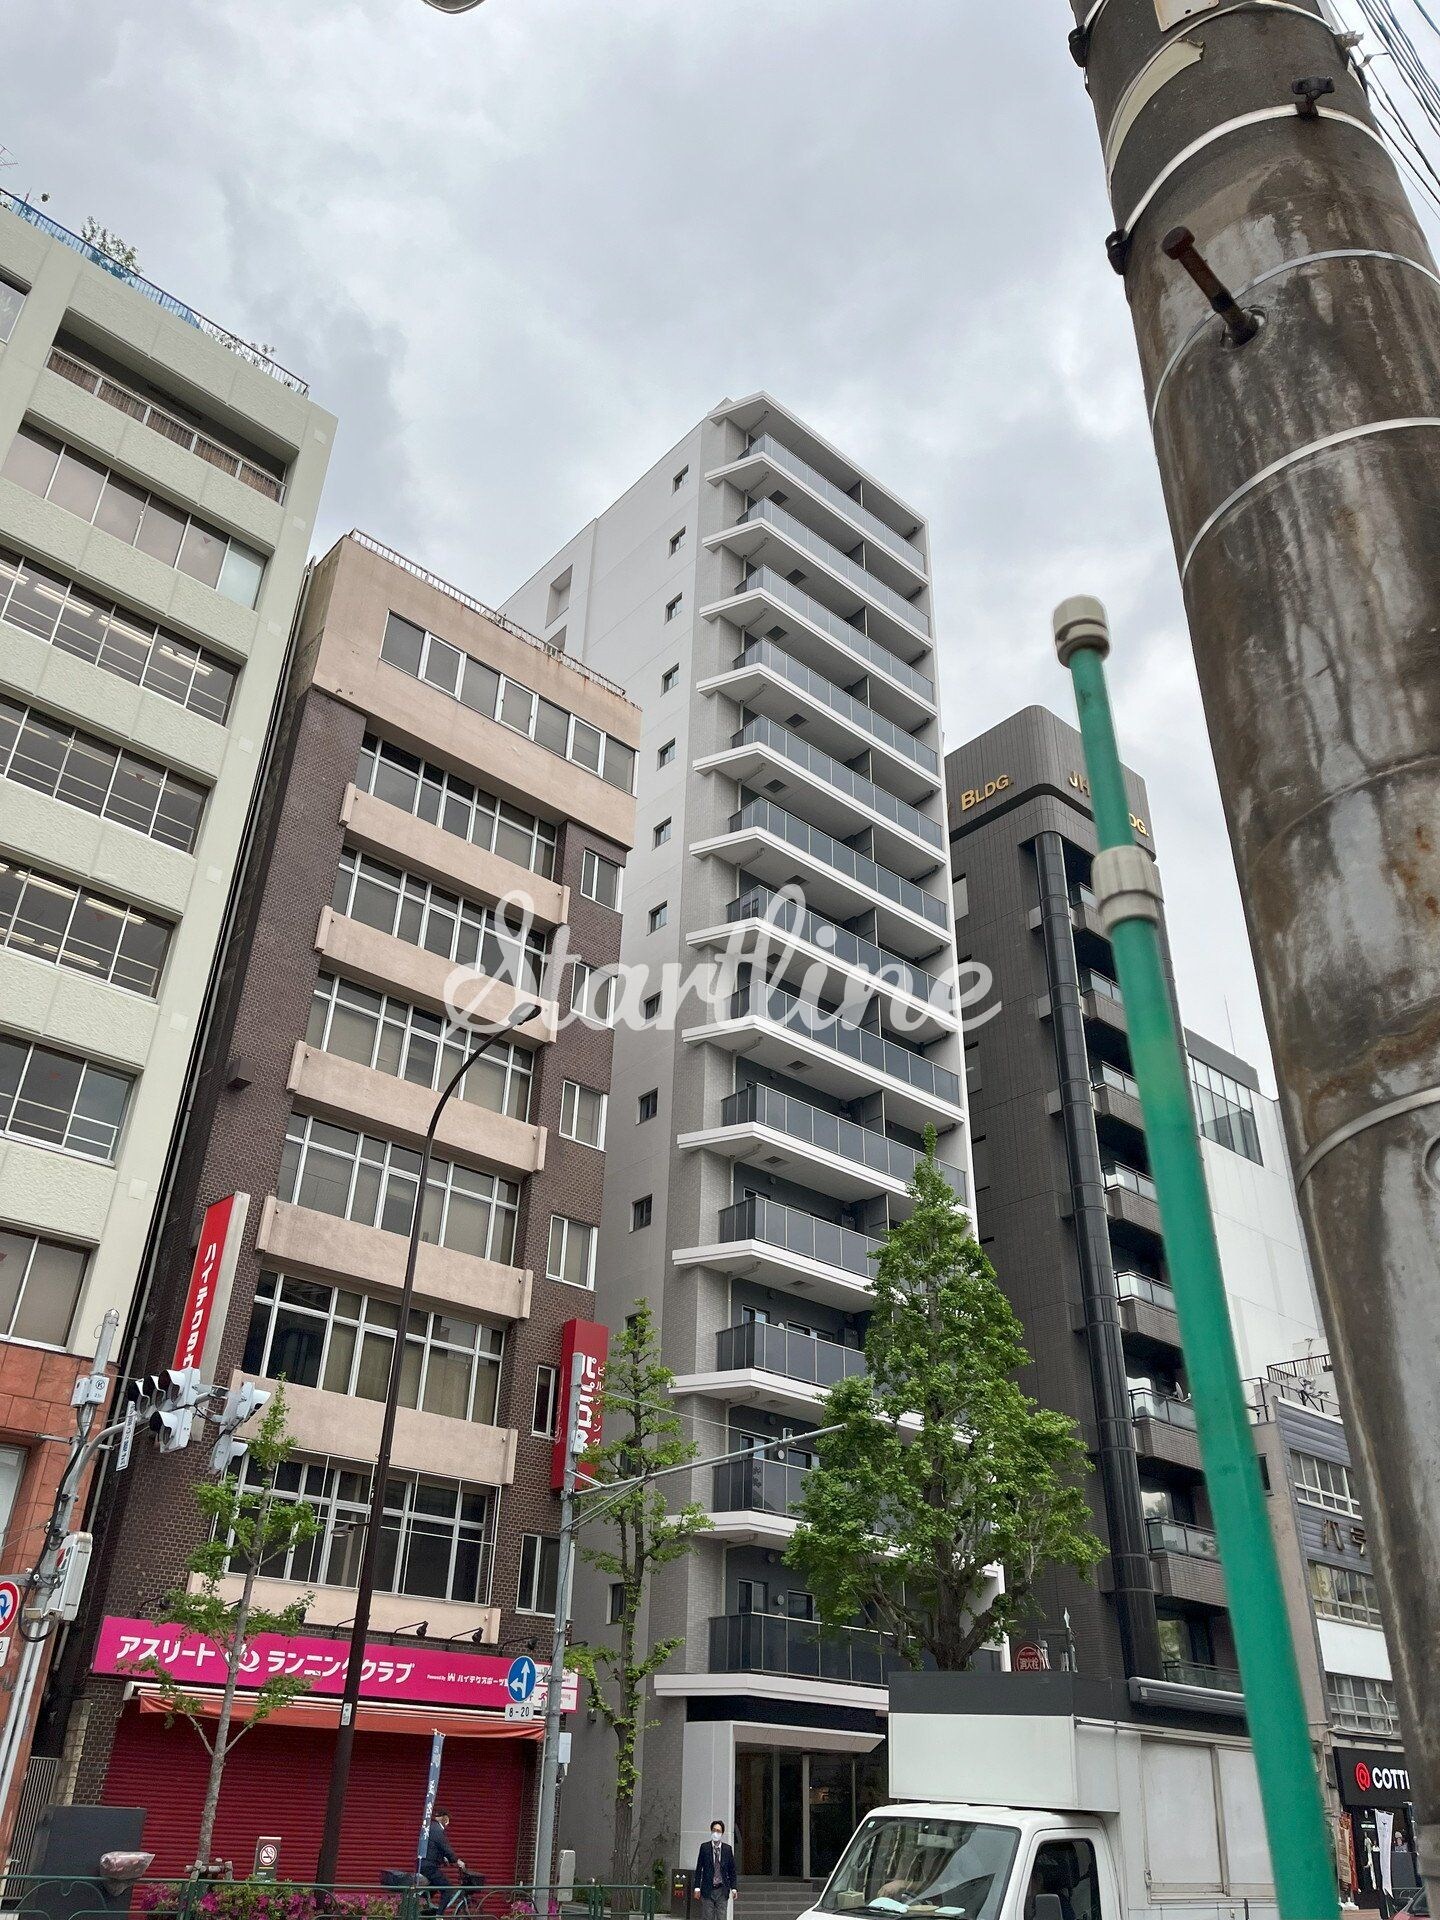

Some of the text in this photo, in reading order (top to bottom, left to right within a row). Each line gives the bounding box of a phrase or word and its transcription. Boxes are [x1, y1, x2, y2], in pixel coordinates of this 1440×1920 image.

[961, 774, 1014, 811] BLDG.
[116, 1635, 216, 1667] アスリート
[1019, 1657, 1039, 1670] 消火栓
[1372, 1767, 1411, 1790] COTTI
